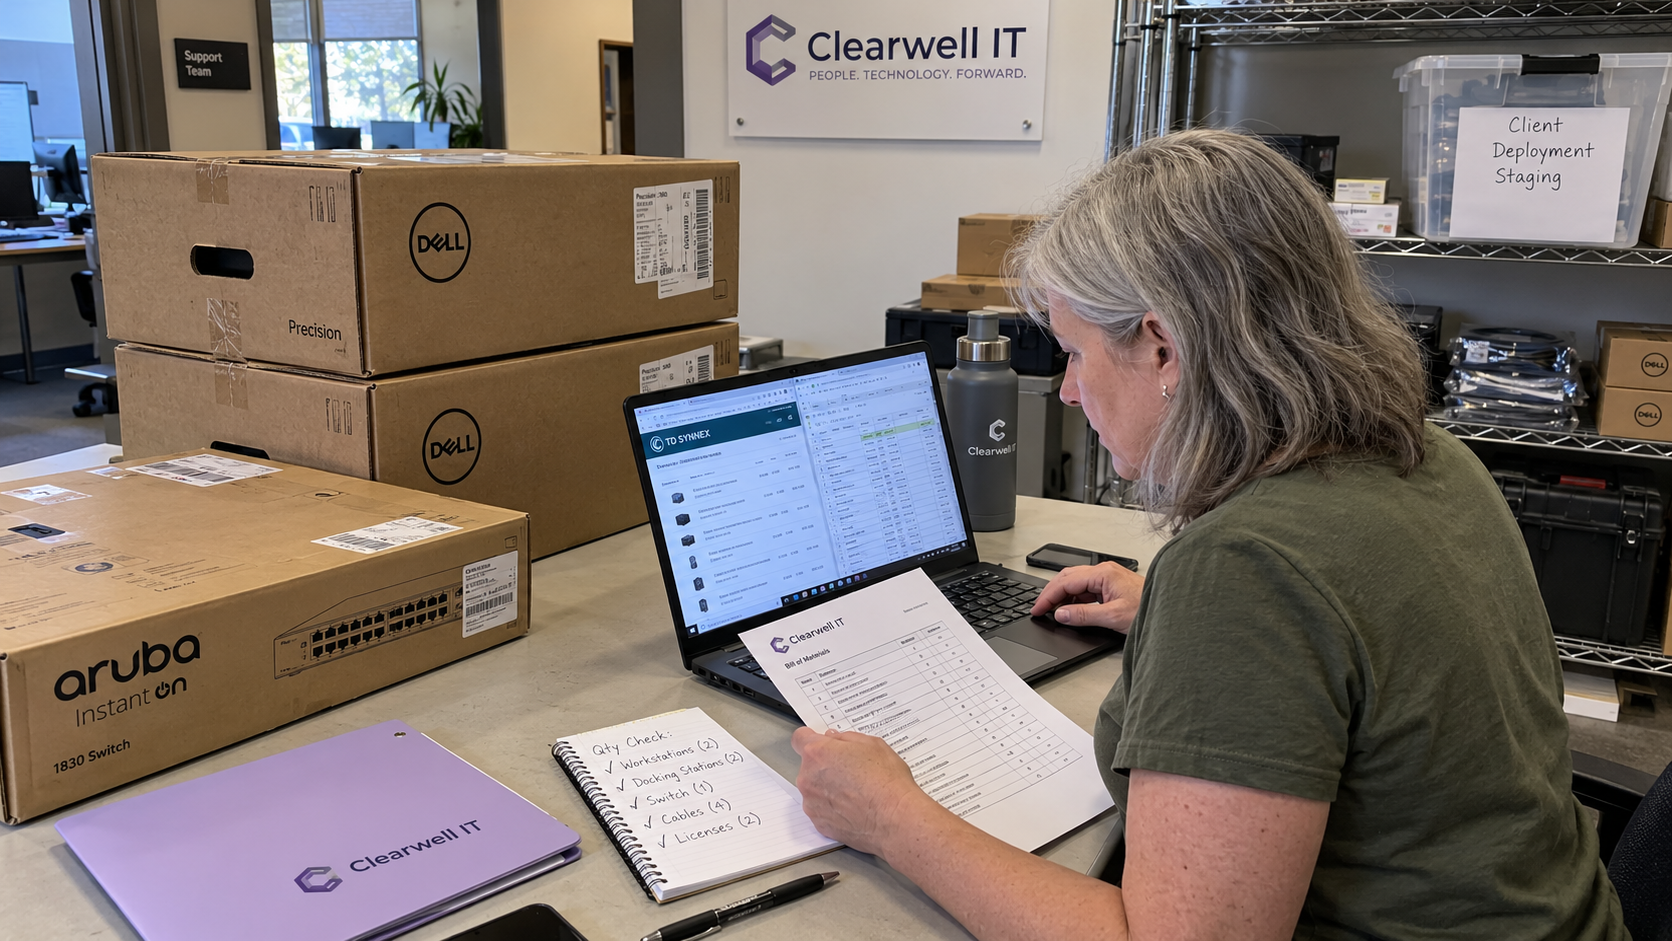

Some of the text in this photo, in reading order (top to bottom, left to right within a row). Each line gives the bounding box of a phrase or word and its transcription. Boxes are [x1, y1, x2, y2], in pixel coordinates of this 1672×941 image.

[184, 50, 223, 64] Support
[808, 27, 1027, 62] Clearwell IT
[185, 65, 212, 77] Team
[809, 68, 1027, 81] PEOPLE. TECHNOLOGY. FORWARD.
[1508, 116, 1563, 133] Client
[1492, 141, 1595, 164] Deployment
[1495, 167, 1561, 191] Staging
[417, 232, 465, 253] DELL
[288, 319, 342, 341] Precision
[430, 434, 475, 460] DELL
[789, 617, 846, 645] Clearwell IT
[54, 634, 200, 701] aruba
[75, 688, 151, 727] Instant
[592, 730, 673, 756] Qty Check:
[619, 737, 719, 770] Workstations (2)
[53, 739, 130, 774] 1830 Switch
[632, 750, 744, 789] Docking Stations (2)
[646, 780, 714, 806] Switch (1)
[661, 798, 732, 825] Cables (4)
[674, 811, 762, 845] Licenses (2)
[350, 819, 482, 872] Clearwell IT
